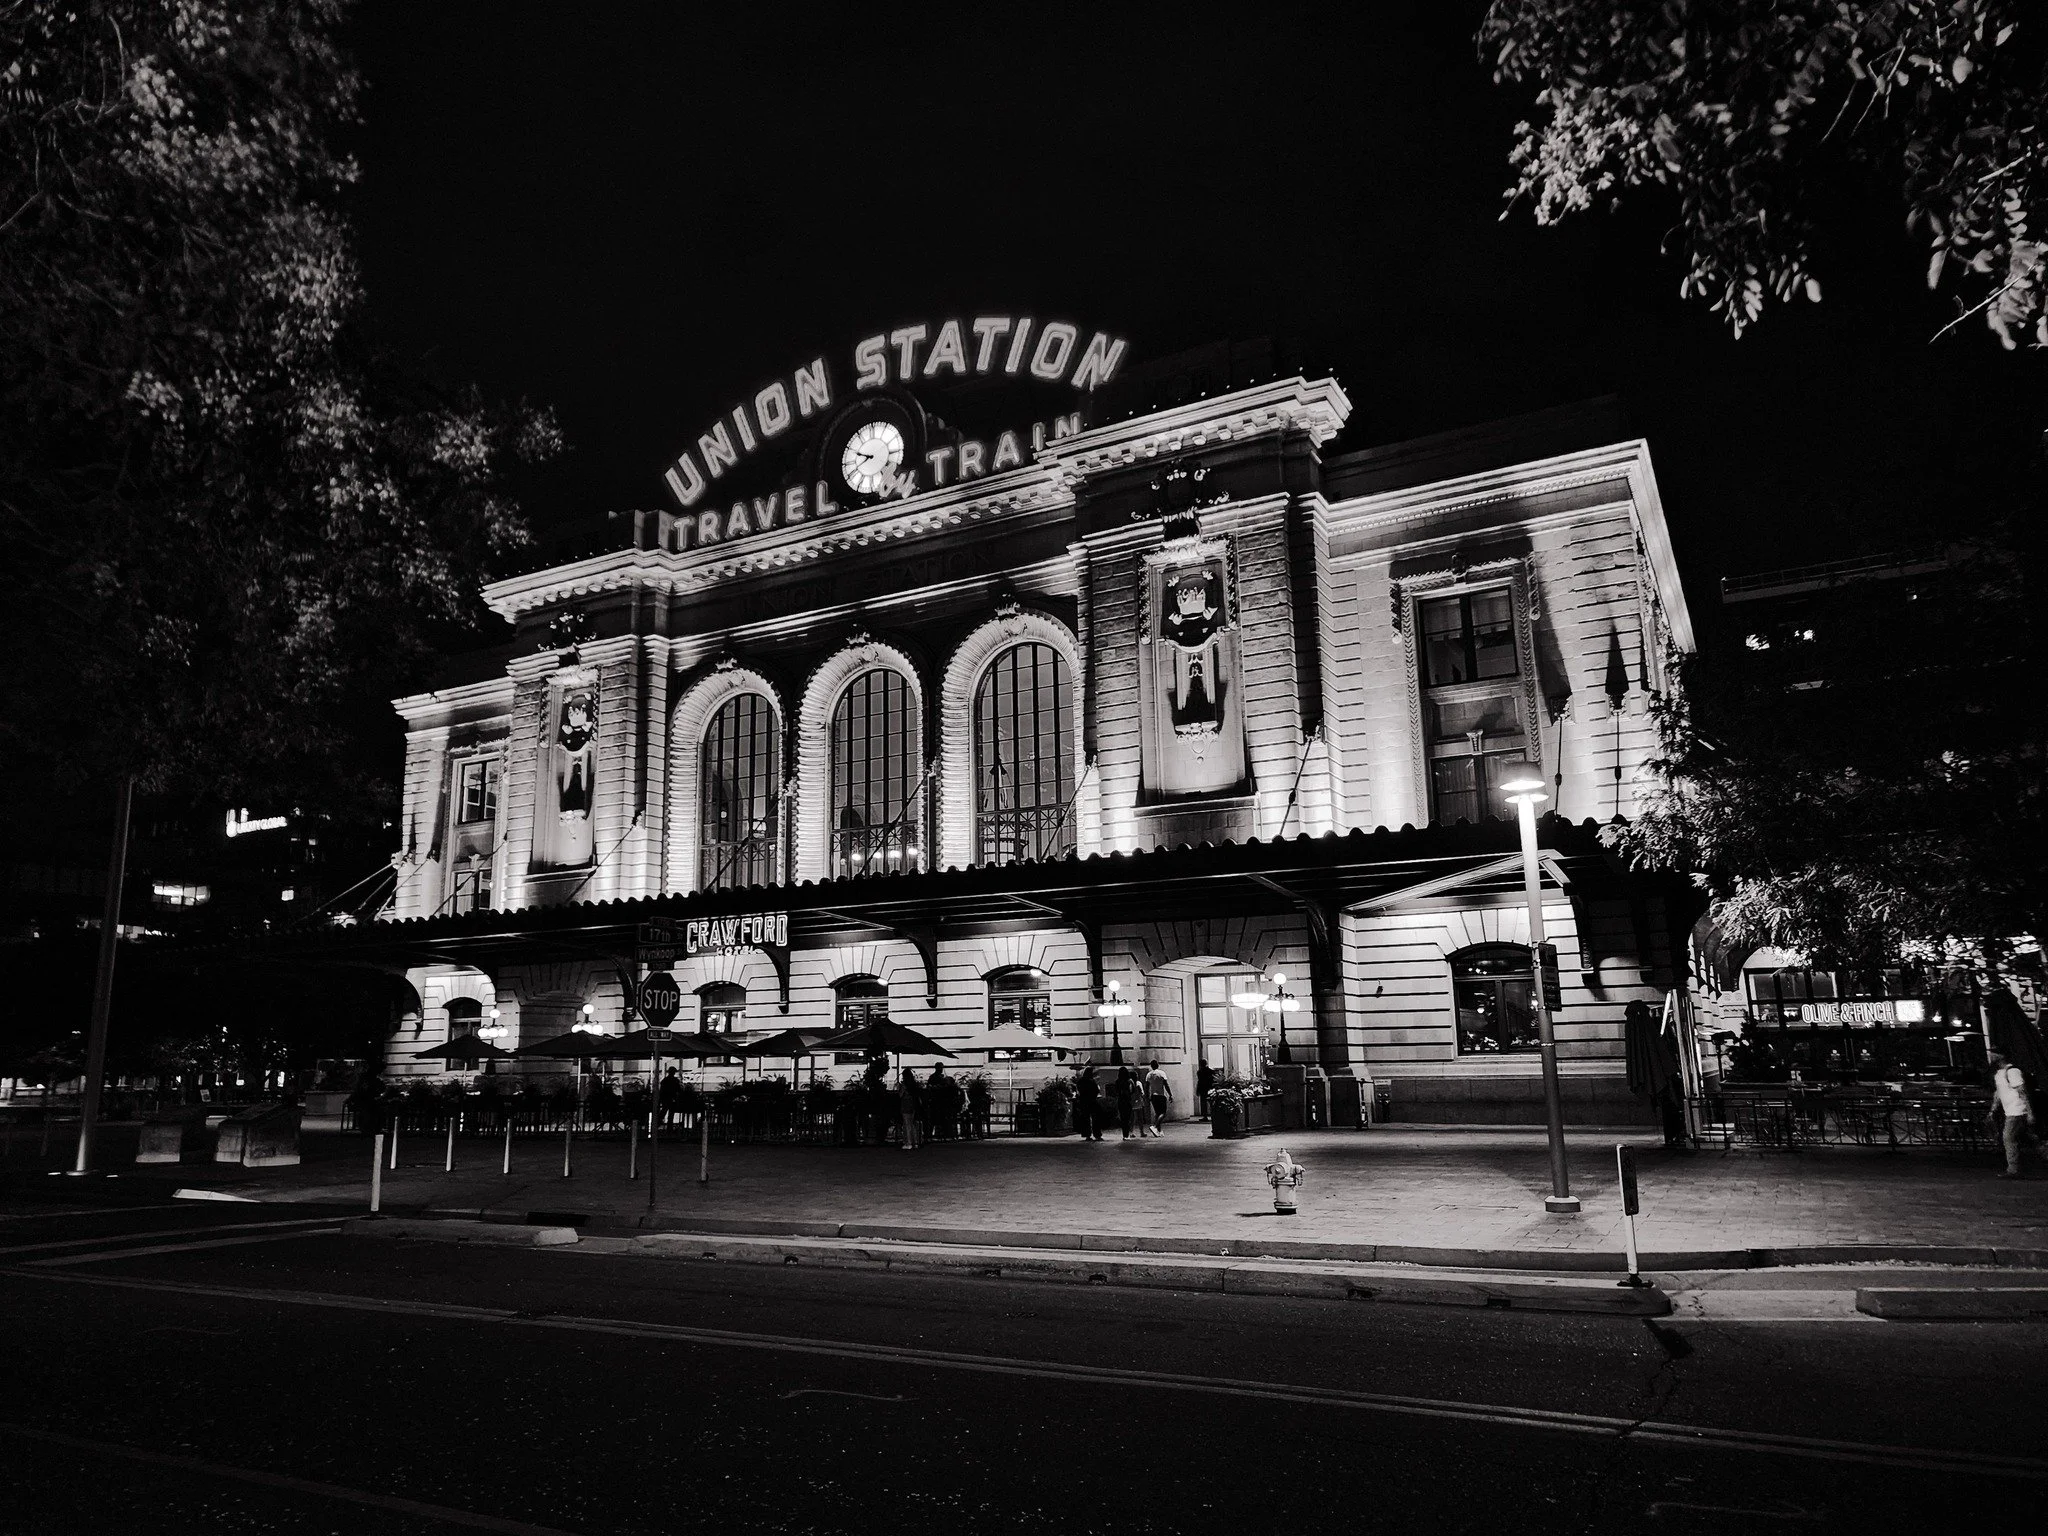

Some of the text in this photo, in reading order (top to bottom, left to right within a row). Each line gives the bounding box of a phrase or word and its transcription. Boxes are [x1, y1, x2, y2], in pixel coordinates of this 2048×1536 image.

[665, 317, 1127, 506] UNION STATION
[672, 480, 839, 551] TRAVEL
[927, 411, 1082, 486] TRAIN
[649, 927, 671, 943] 17th
[686, 914, 788, 954] CRAWFORD
[644, 988, 679, 1011] STOP
[1801, 1002, 1840, 1024] OLIVE
[1854, 1001, 1895, 1022] FINCH
